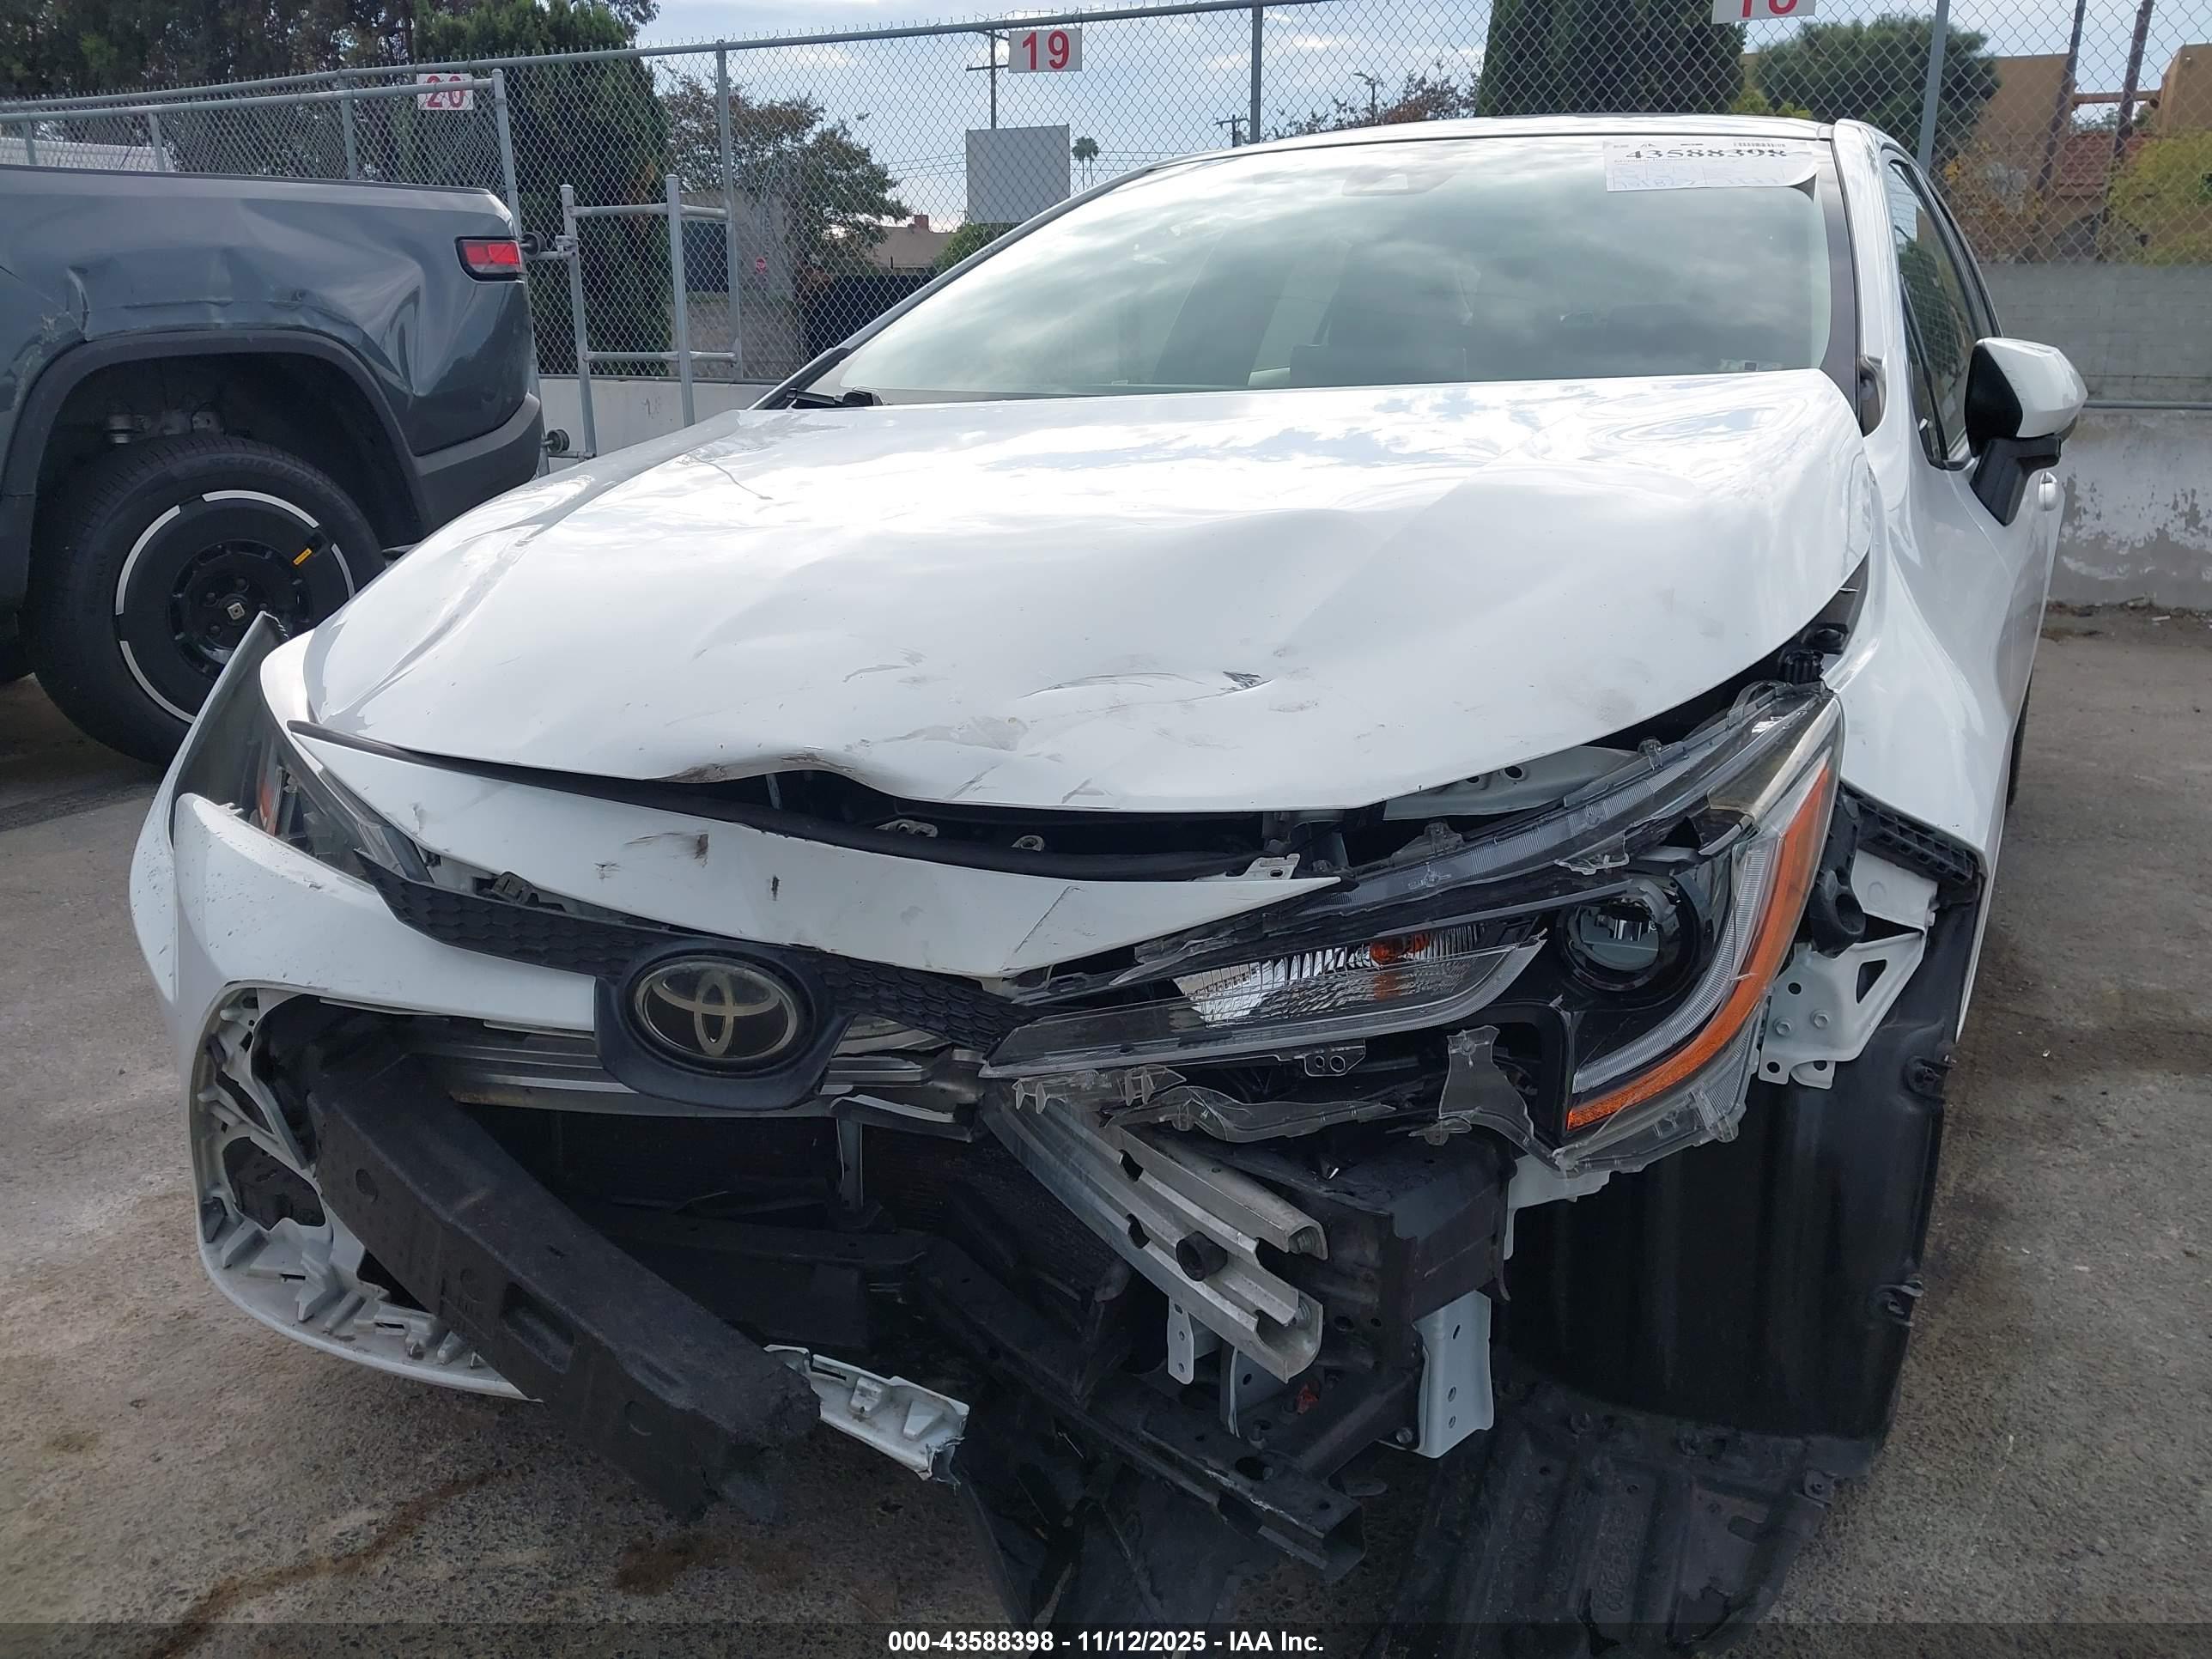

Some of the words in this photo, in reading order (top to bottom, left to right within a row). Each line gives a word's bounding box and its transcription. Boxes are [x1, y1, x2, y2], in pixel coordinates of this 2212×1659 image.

[1022, 30, 1070, 70] 19
[426, 75, 465, 108] 20
[1626, 149, 1787, 159] 43588398
